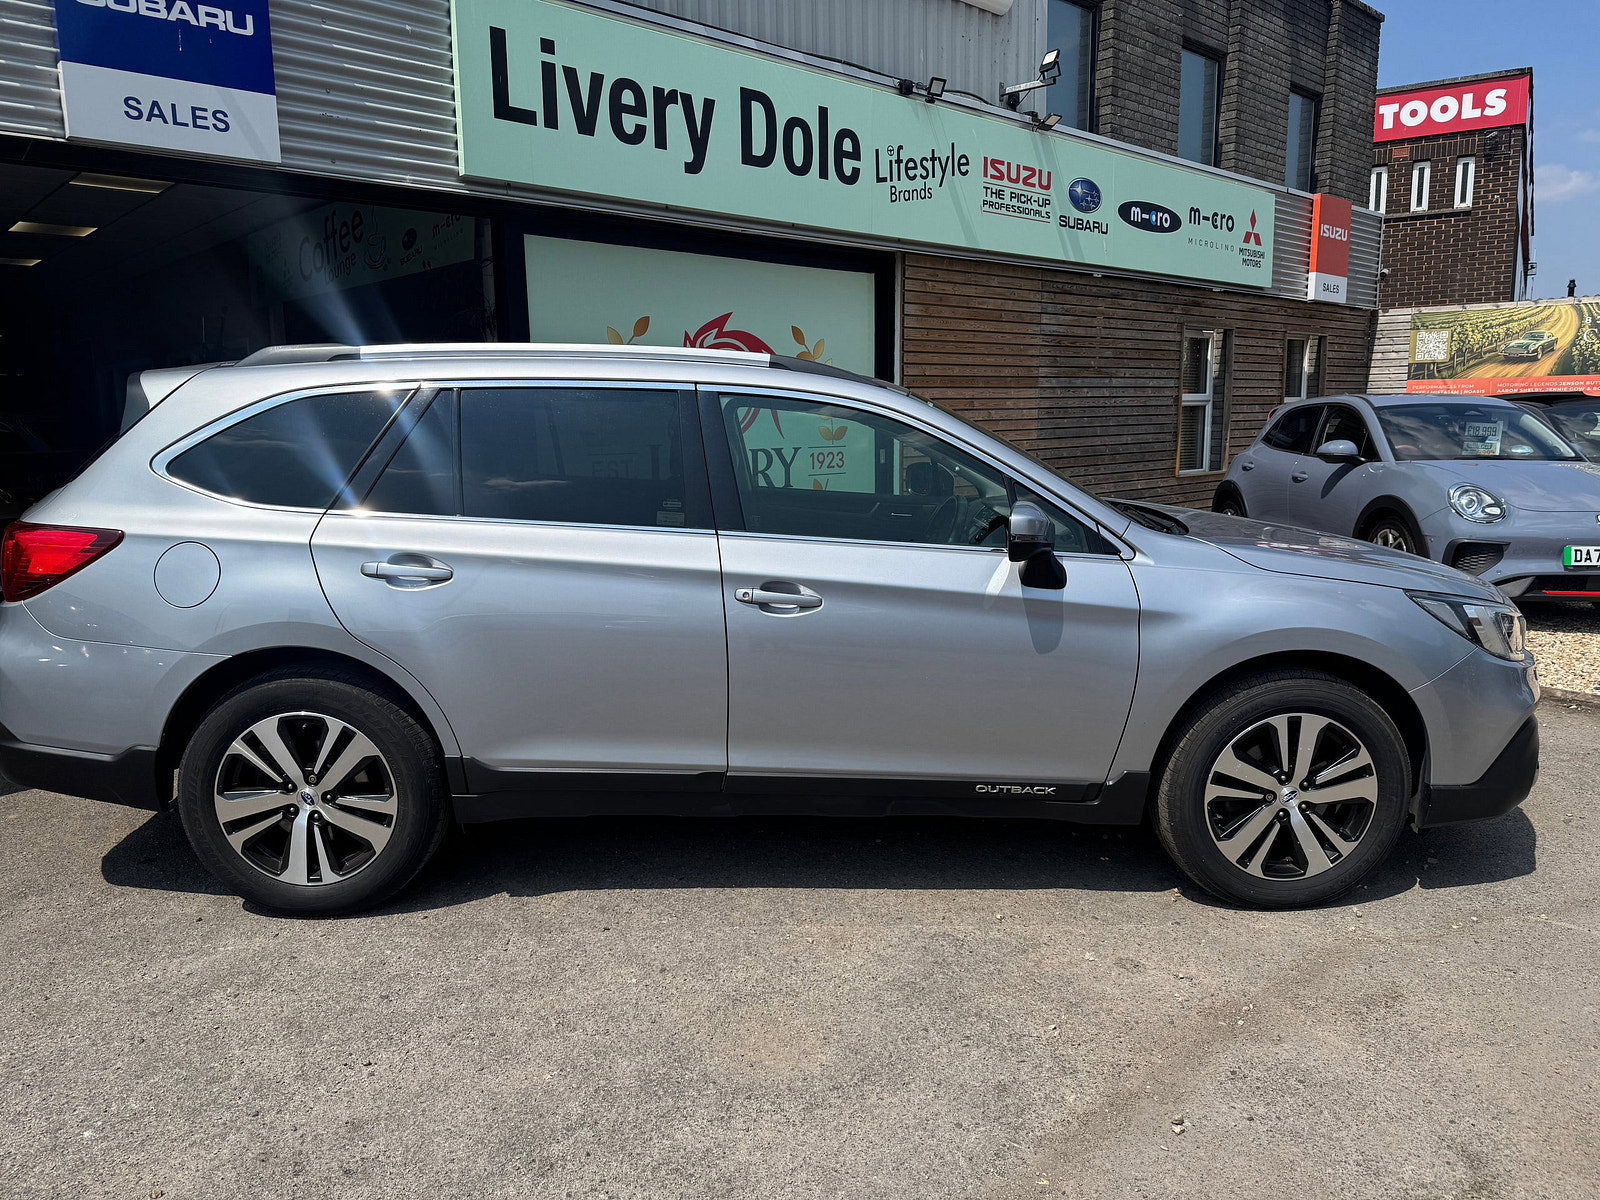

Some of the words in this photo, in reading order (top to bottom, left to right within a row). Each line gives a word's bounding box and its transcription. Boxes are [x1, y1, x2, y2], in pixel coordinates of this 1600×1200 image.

[123, 96, 231, 133] SALES
[488, 25, 716, 175] Livery
[739, 86, 862, 186] Dole
[1378, 88, 1508, 130] TOOLS
[874, 142, 970, 188] Lifestyle
[982, 156, 1052, 191] ISUZU
[889, 181, 933, 203] Brands
[982, 185, 1006, 200] THE
[1009, 191, 1051, 209] PICK-UP
[982, 199, 1051, 219] PROFESSIONALS
[1058, 214, 1109, 236] SUBARU
[1320, 223, 1348, 242] ISUZU
[299, 209, 364, 282] Coffee
[1187, 236, 1236, 253] MICROLINO
[1238, 246, 1266, 260] MITSUBISHI
[1241, 257, 1262, 269] MOTORS
[1322, 282, 1340, 294] SALES
[809, 450, 845, 470] 1923
[975, 784, 1057, 795] OUTBACK
